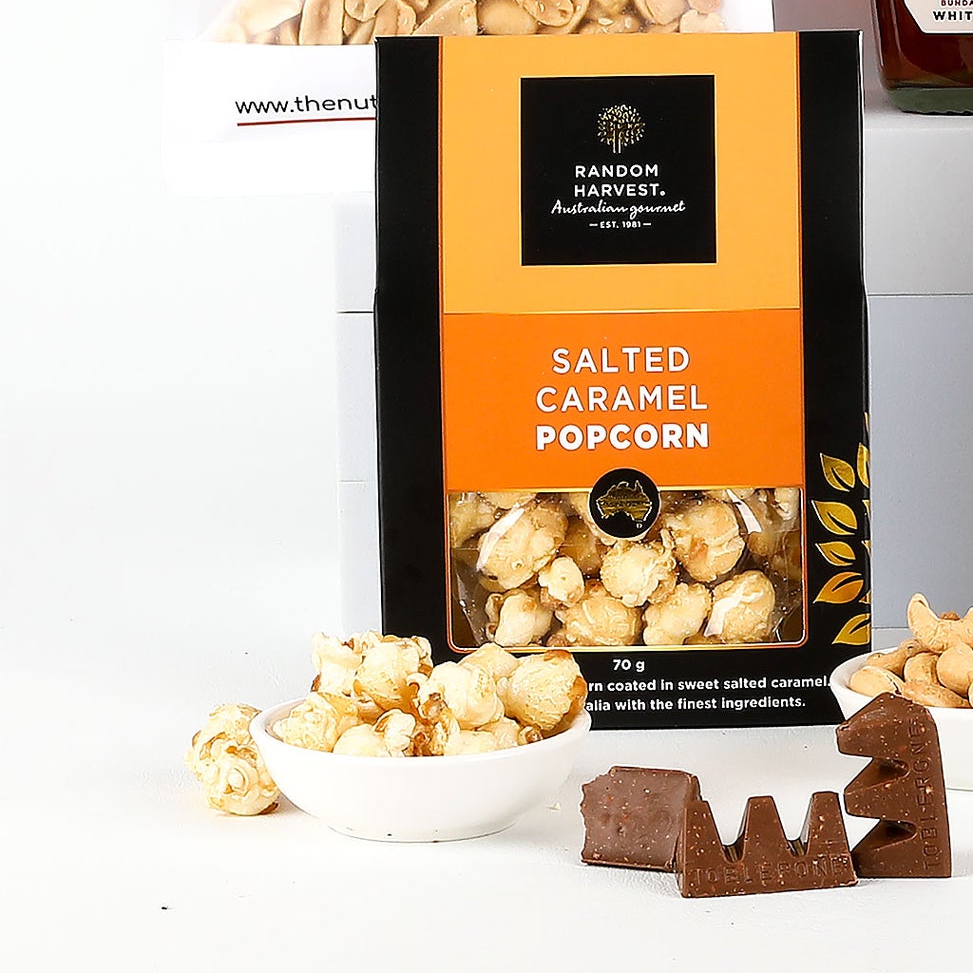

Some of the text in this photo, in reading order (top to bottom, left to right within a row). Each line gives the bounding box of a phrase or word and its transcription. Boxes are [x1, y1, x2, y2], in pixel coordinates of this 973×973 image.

[575, 164, 659, 178] RANDOM
[551, 198, 686, 220] Australian gourmet
[600, 220, 642, 229] EST. 1981
[551, 346, 691, 374] SALTED
[535, 384, 709, 413] CARAMEL
[535, 422, 710, 451] POPCORN
[612, 658, 645, 673] 70 g
[607, 679, 657, 692] coated
[660, 678, 674, 691] in
[677, 679, 719, 691] sweet
[723, 676, 767, 689] salted
[614, 698, 646, 711] with
[649, 698, 674, 711] the
[677, 697, 717, 710] finest
[721, 695, 806, 711] ingredients.
